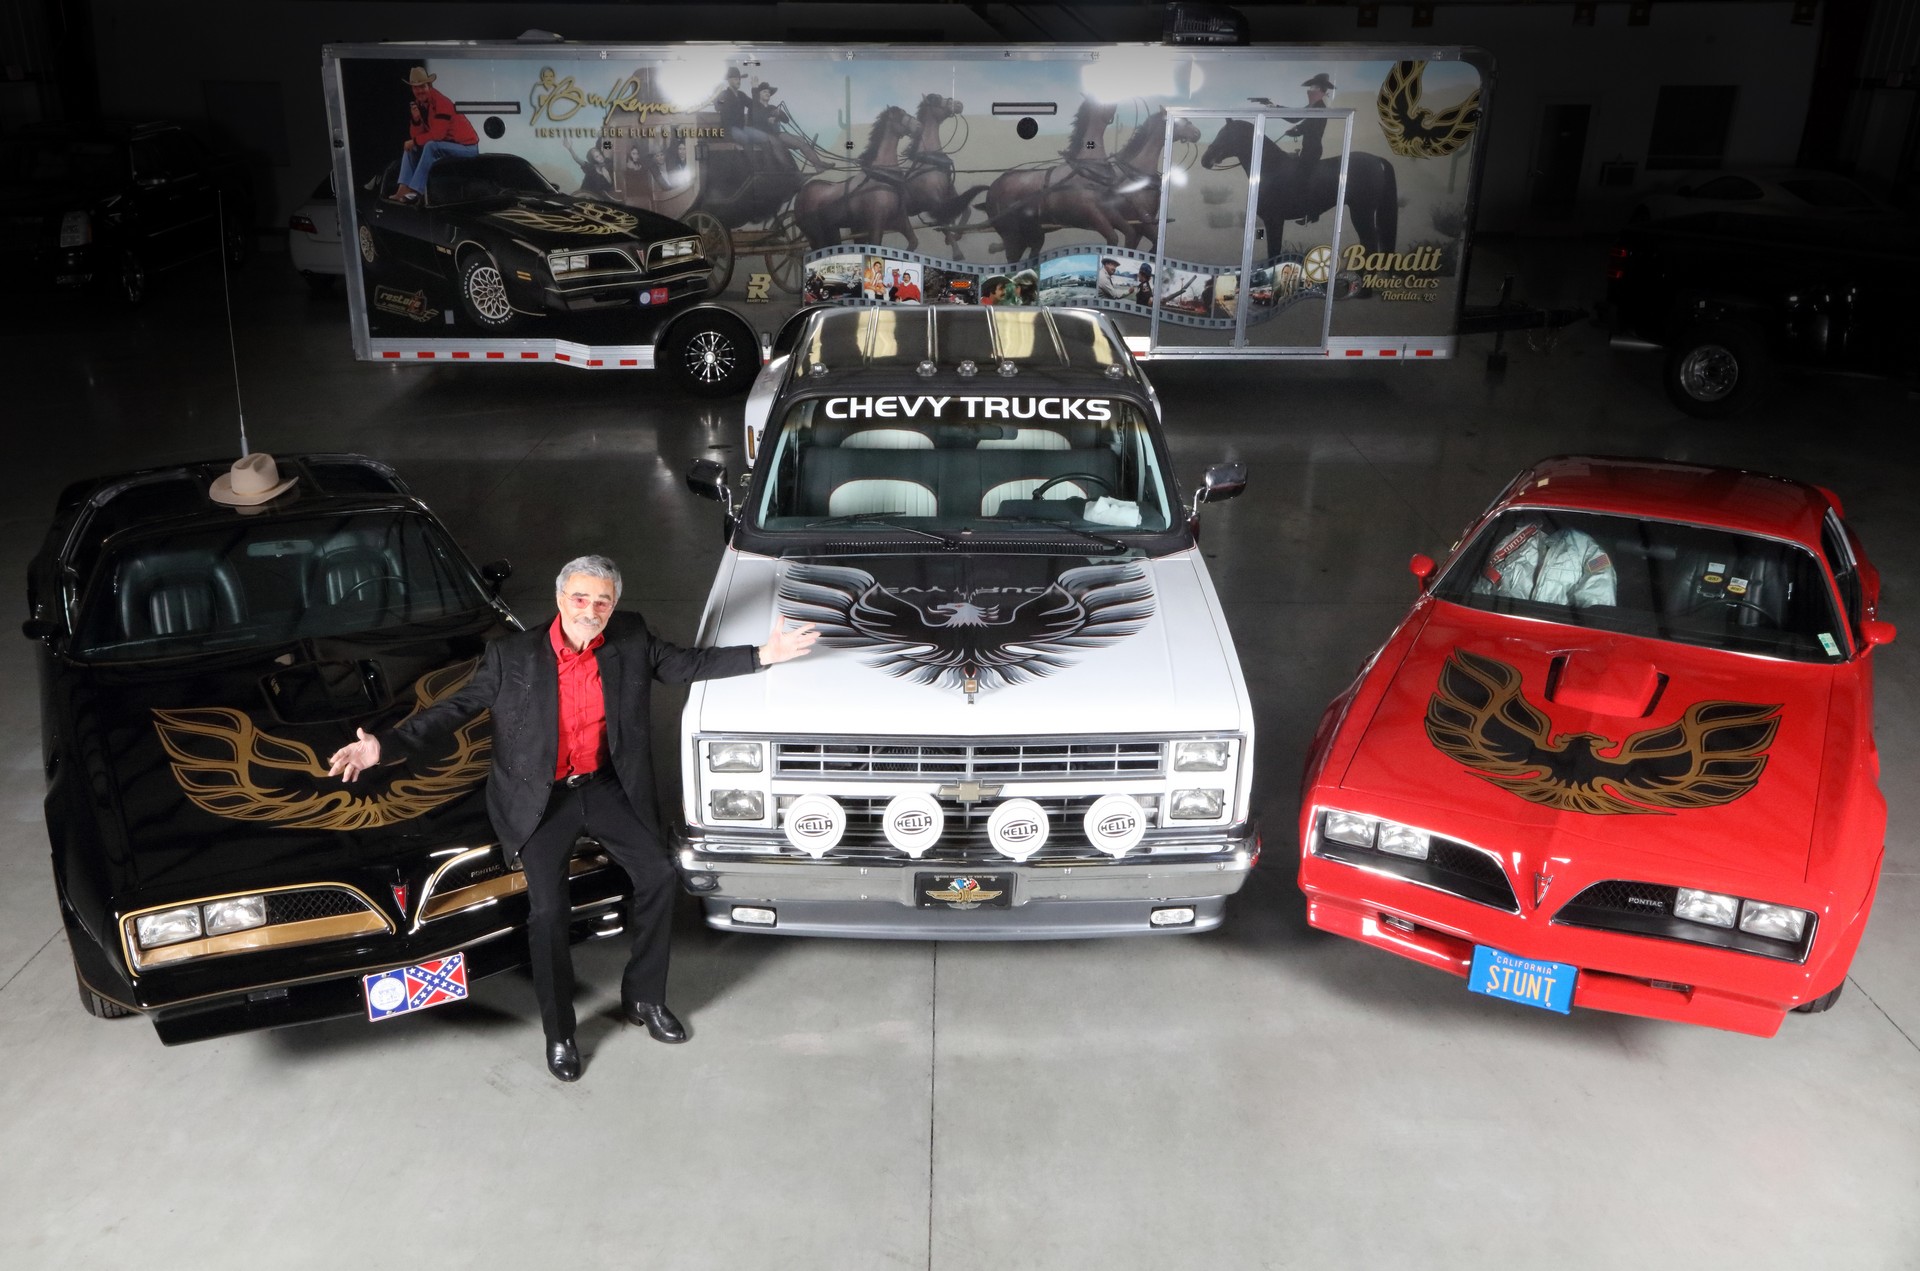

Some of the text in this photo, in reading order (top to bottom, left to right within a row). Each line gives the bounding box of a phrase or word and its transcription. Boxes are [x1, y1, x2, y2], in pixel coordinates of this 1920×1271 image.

[535, 127, 725, 138] INSTITUTE FOR FILM & THEATRE
[1343, 244, 1443, 272] Bandit
[1362, 274, 1440, 289] Movie Cars
[825, 395, 1112, 421] CHEVY TRUCKS
[797, 819, 833, 831] HELLA
[896, 815, 933, 828] HELLA
[1101, 818, 1136, 832] HELLA
[1003, 824, 1039, 836] HELLA
[1628, 896, 1664, 908] PONTIAC
[1496, 955, 1553, 976] CALIFORNIA
[1487, 964, 1557, 1003] STUNT
